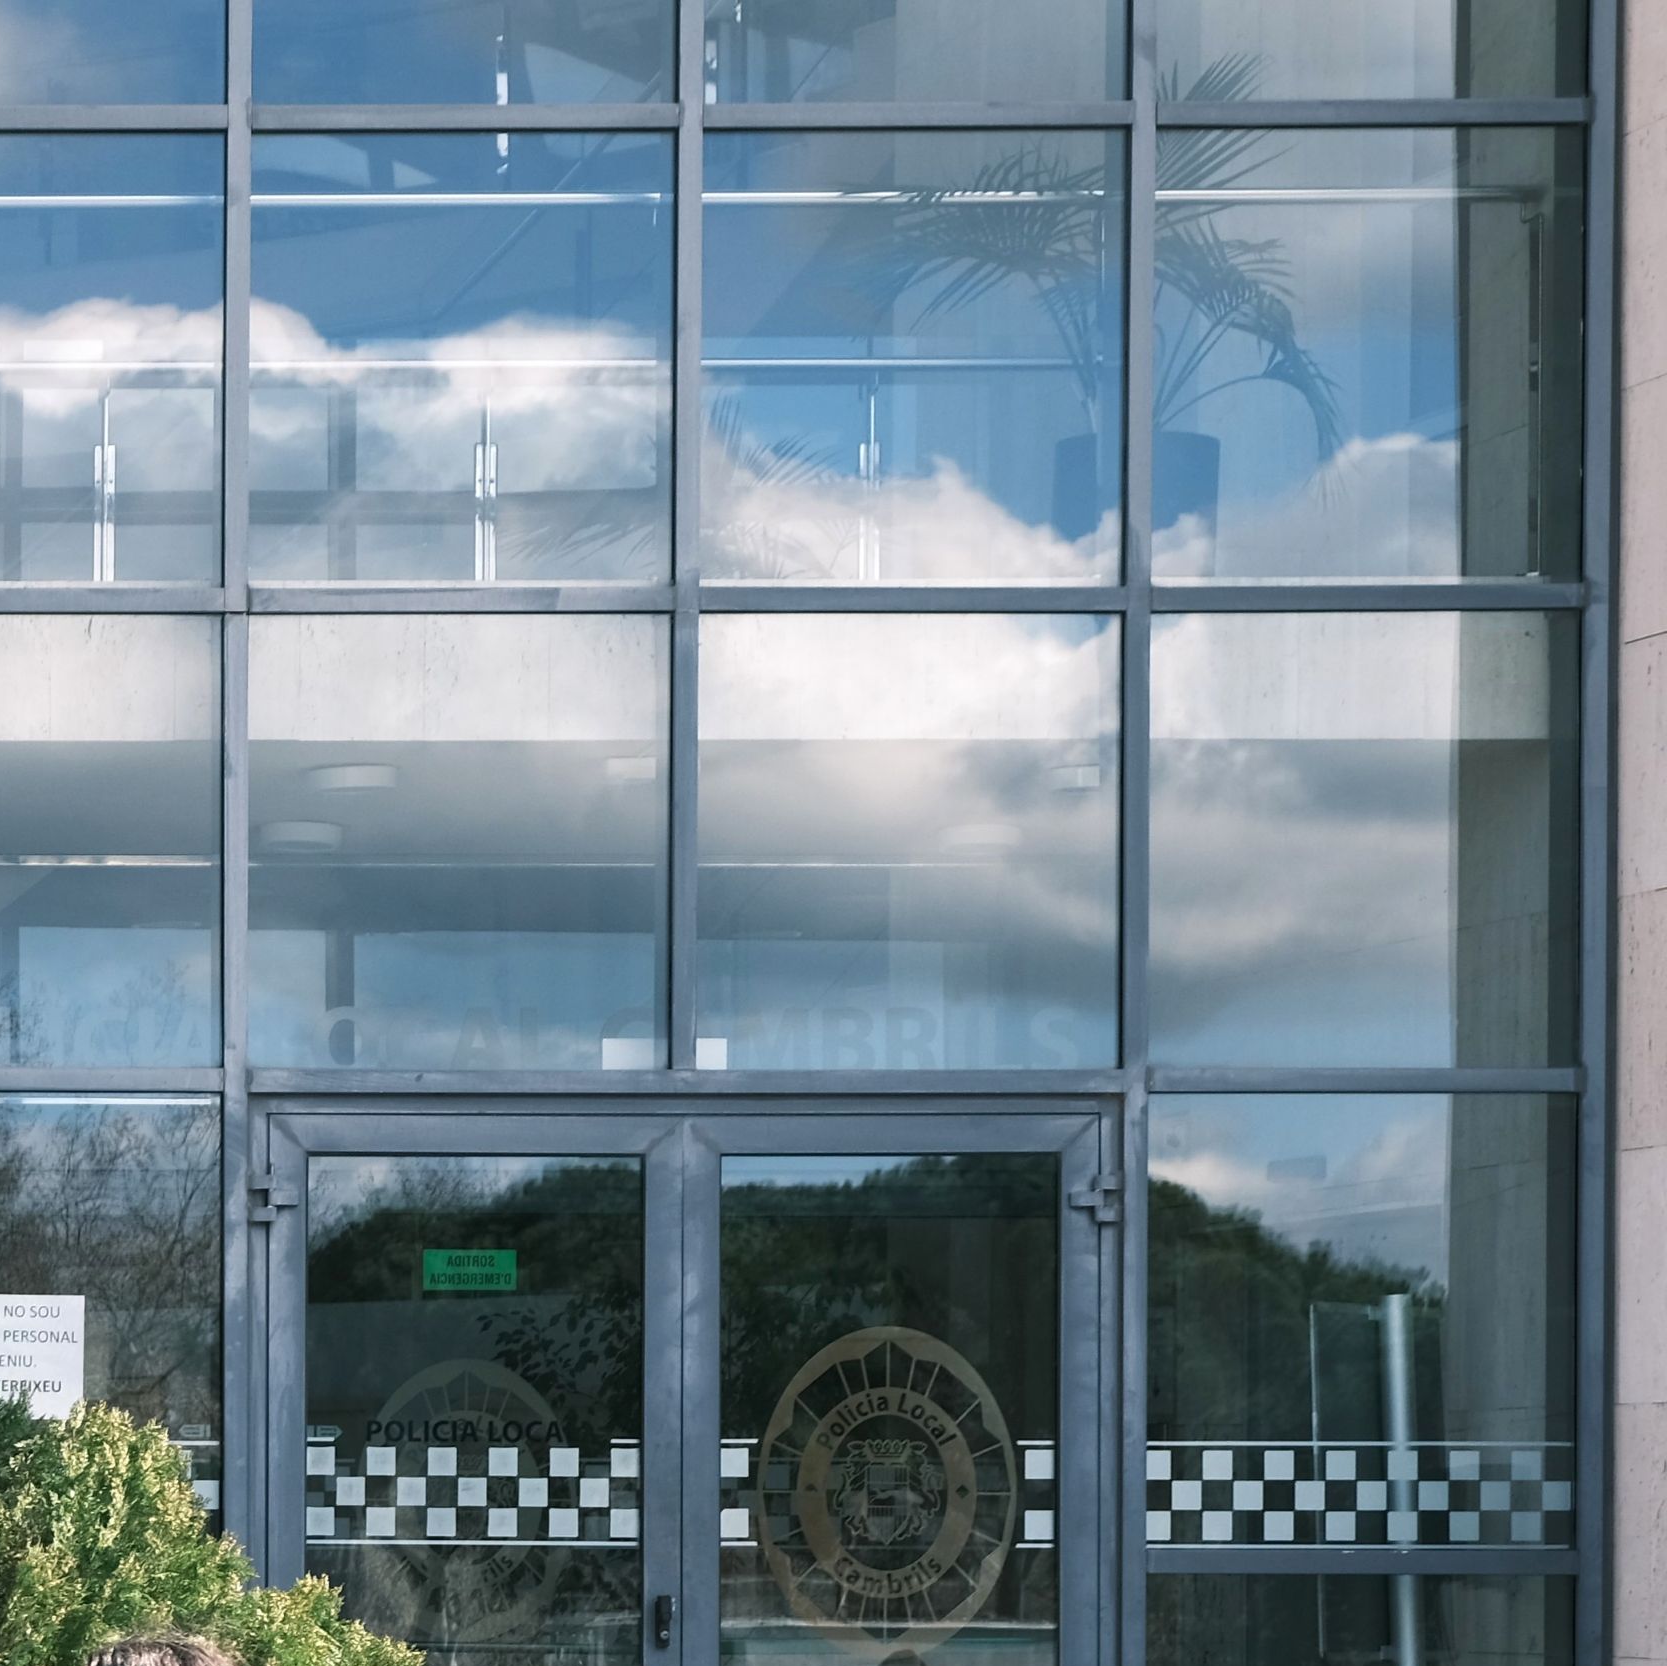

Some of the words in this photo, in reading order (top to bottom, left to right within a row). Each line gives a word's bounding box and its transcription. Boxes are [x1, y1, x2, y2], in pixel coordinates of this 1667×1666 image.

[3, 1305, 26, 1318] NO
[30, 1305, 60, 1318] SOU
[3, 1330, 78, 1344] PERSONAL
[367, 1420, 479, 1443] POLICIA
[817, 1393, 891, 1451] Policia
[897, 1392, 958, 1447] Local
[832, 1554, 943, 1595] Cambrils
